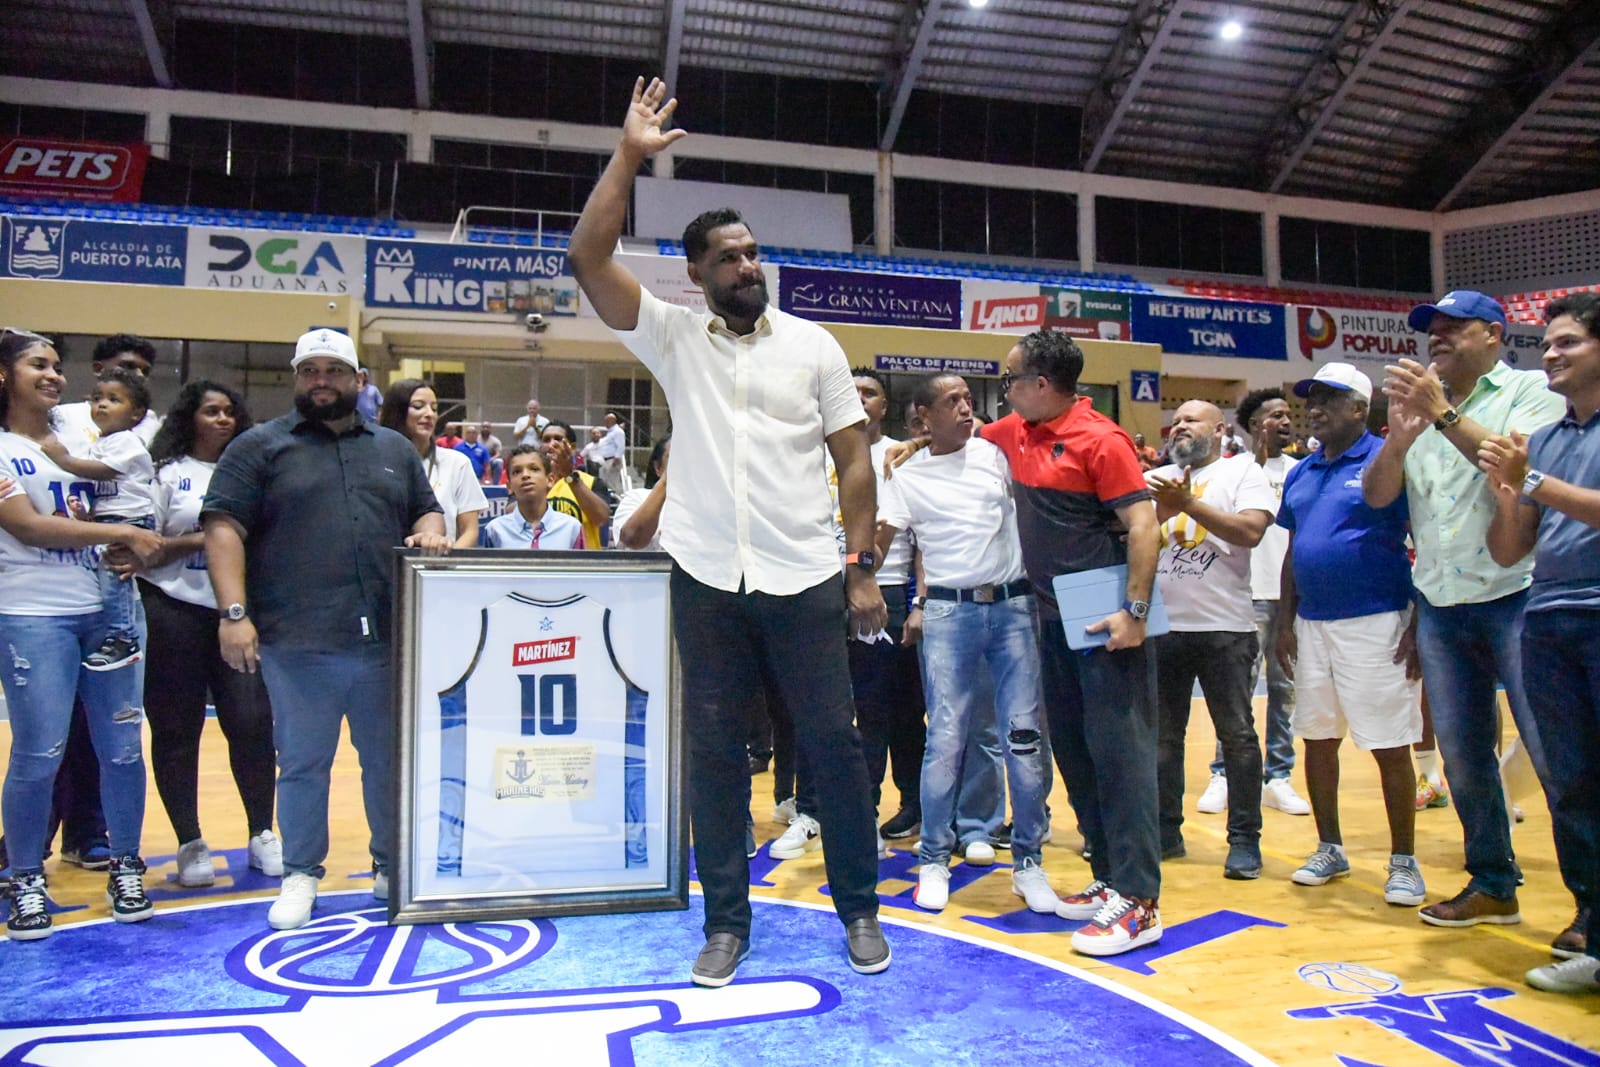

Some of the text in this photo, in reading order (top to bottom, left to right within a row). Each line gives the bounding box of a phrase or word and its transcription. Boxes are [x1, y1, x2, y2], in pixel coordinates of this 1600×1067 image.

[4, 146, 118, 181] PETS
[83, 241, 172, 254] ALCALDIA DE
[208, 234, 345, 276] DGA
[71, 251, 182, 270] PUERTO PLATA
[453, 253, 564, 276] PINTA MÁS!
[208, 274, 347, 294] ADUANAS
[374, 266, 481, 306] KING
[828, 293, 953, 315] GRAN VENTANA
[977, 299, 1039, 329] LANCO
[1148, 302, 1273, 325] REFRIPARTES
[1188, 328, 1237, 349] TGM
[1342, 334, 1418, 356] POPULAR
[881, 356, 993, 369] PALCO DE PRENSA
[1136, 379, 1154, 401] A
[11, 457, 36, 477] 10
[517, 640, 570, 662] MARTÍNEZ
[517, 673, 578, 736] 10
